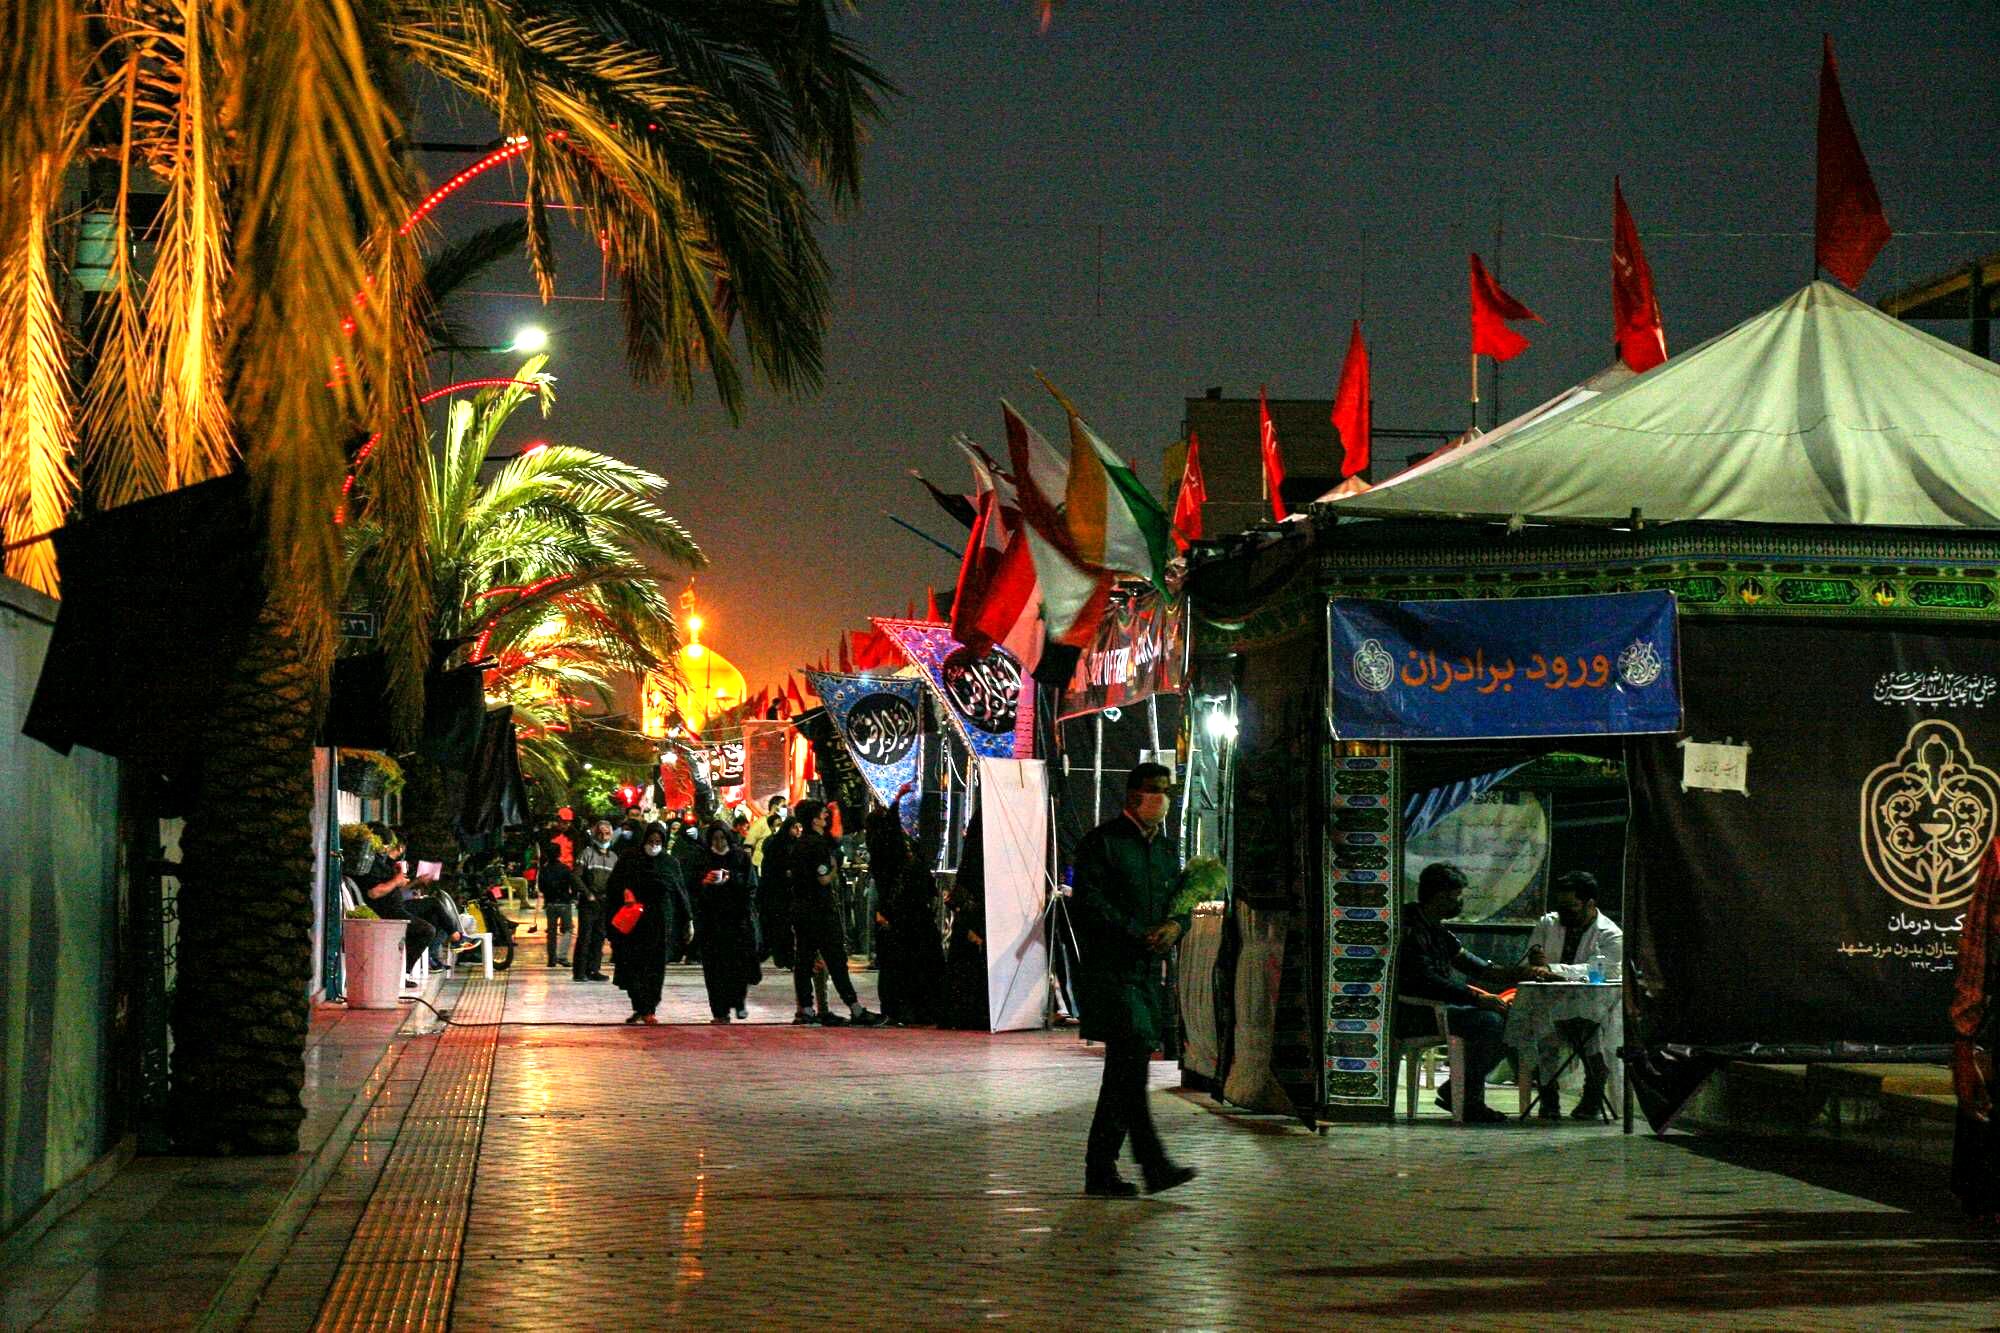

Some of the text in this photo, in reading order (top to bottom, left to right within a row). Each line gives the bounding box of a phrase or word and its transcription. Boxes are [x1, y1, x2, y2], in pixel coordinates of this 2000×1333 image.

[1400, 647, 1514, 694] برادران
[1525, 649, 1611, 689] ورود
[1887, 911, 1931, 935] درمان
[1837, 941, 1873, 957] مشهد
[1873, 942, 1892, 959] مرز
[1894, 941, 1923, 958] بدون
